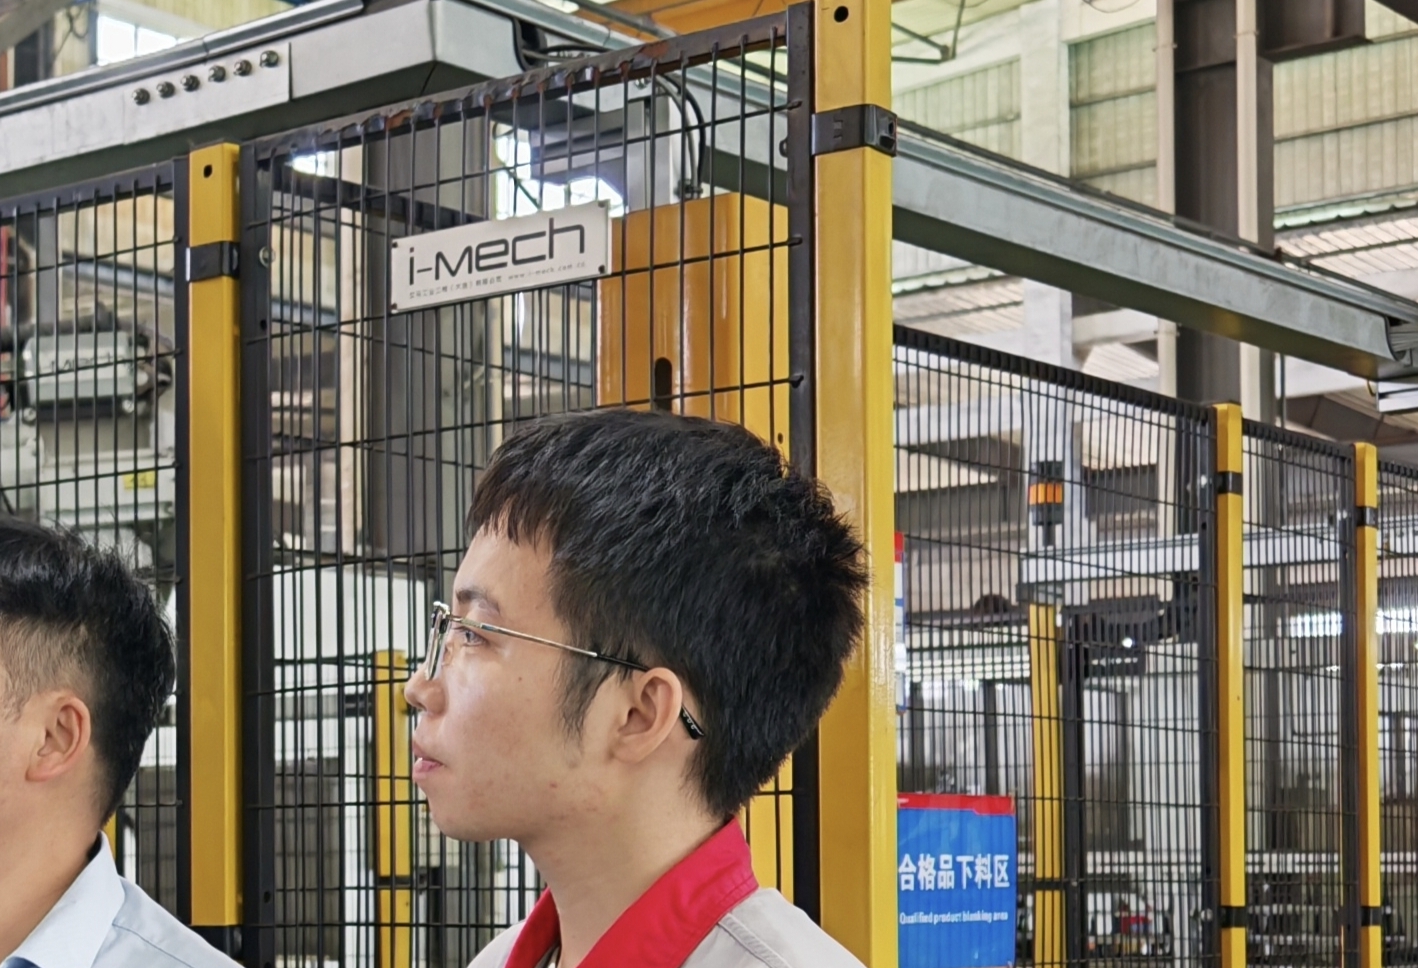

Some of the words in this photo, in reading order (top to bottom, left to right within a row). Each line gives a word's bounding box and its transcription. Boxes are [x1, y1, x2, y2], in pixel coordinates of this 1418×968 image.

[898, 853, 1010, 891] 合格品下料区
[899, 911, 933, 925] Qualified
[933, 911, 962, 926] product
[962, 909, 992, 924] blanking
